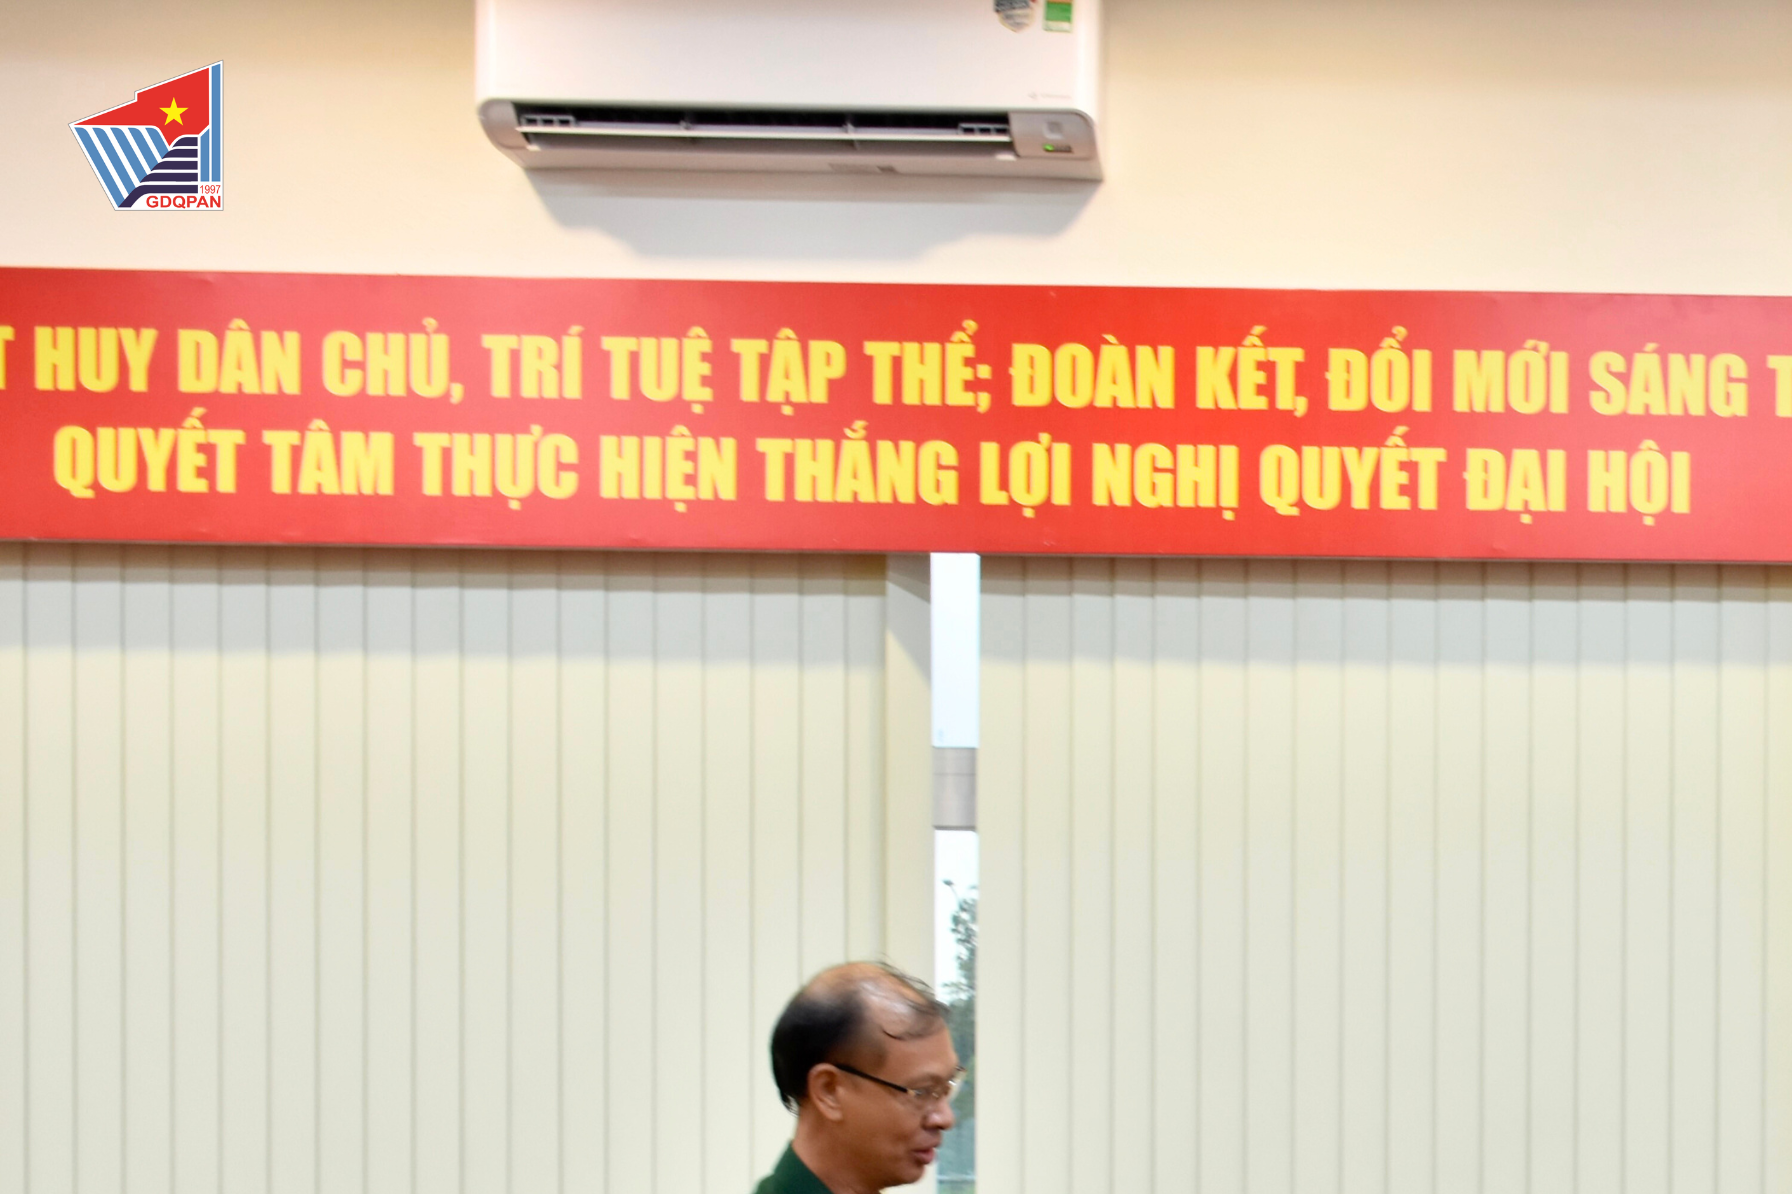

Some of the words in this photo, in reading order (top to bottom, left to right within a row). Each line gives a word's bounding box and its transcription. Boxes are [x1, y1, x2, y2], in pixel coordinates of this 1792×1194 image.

[34, 325, 158, 393] HUY
[177, 317, 301, 395] DÂN
[322, 317, 465, 404] CHỦ,
[481, 324, 585, 401] TRÍ
[600, 325, 713, 414] TUỆ
[730, 326, 846, 416] TẬP
[863, 318, 993, 413] THỂ;
[1009, 334, 1175, 410] ĐOÀN
[1195, 325, 1308, 418] KẾT,
[1325, 325, 1432, 413] ĐỔI
[1453, 339, 1569, 415] MỚI
[1588, 342, 1749, 418] SÁNG
[53, 406, 246, 498] QUYẾT
[261, 418, 395, 495] TÂM
[413, 423, 579, 510] THỰC
[599, 424, 738, 512] HIỆN
[755, 419, 959, 506] THẮNG
[979, 432, 1072, 518] LỢI
[1092, 442, 1239, 521] NGHỊ
[1259, 425, 1447, 516] QUYẾT
[1462, 447, 1567, 524] ĐẠI
[1587, 438, 1691, 526] HỘI
